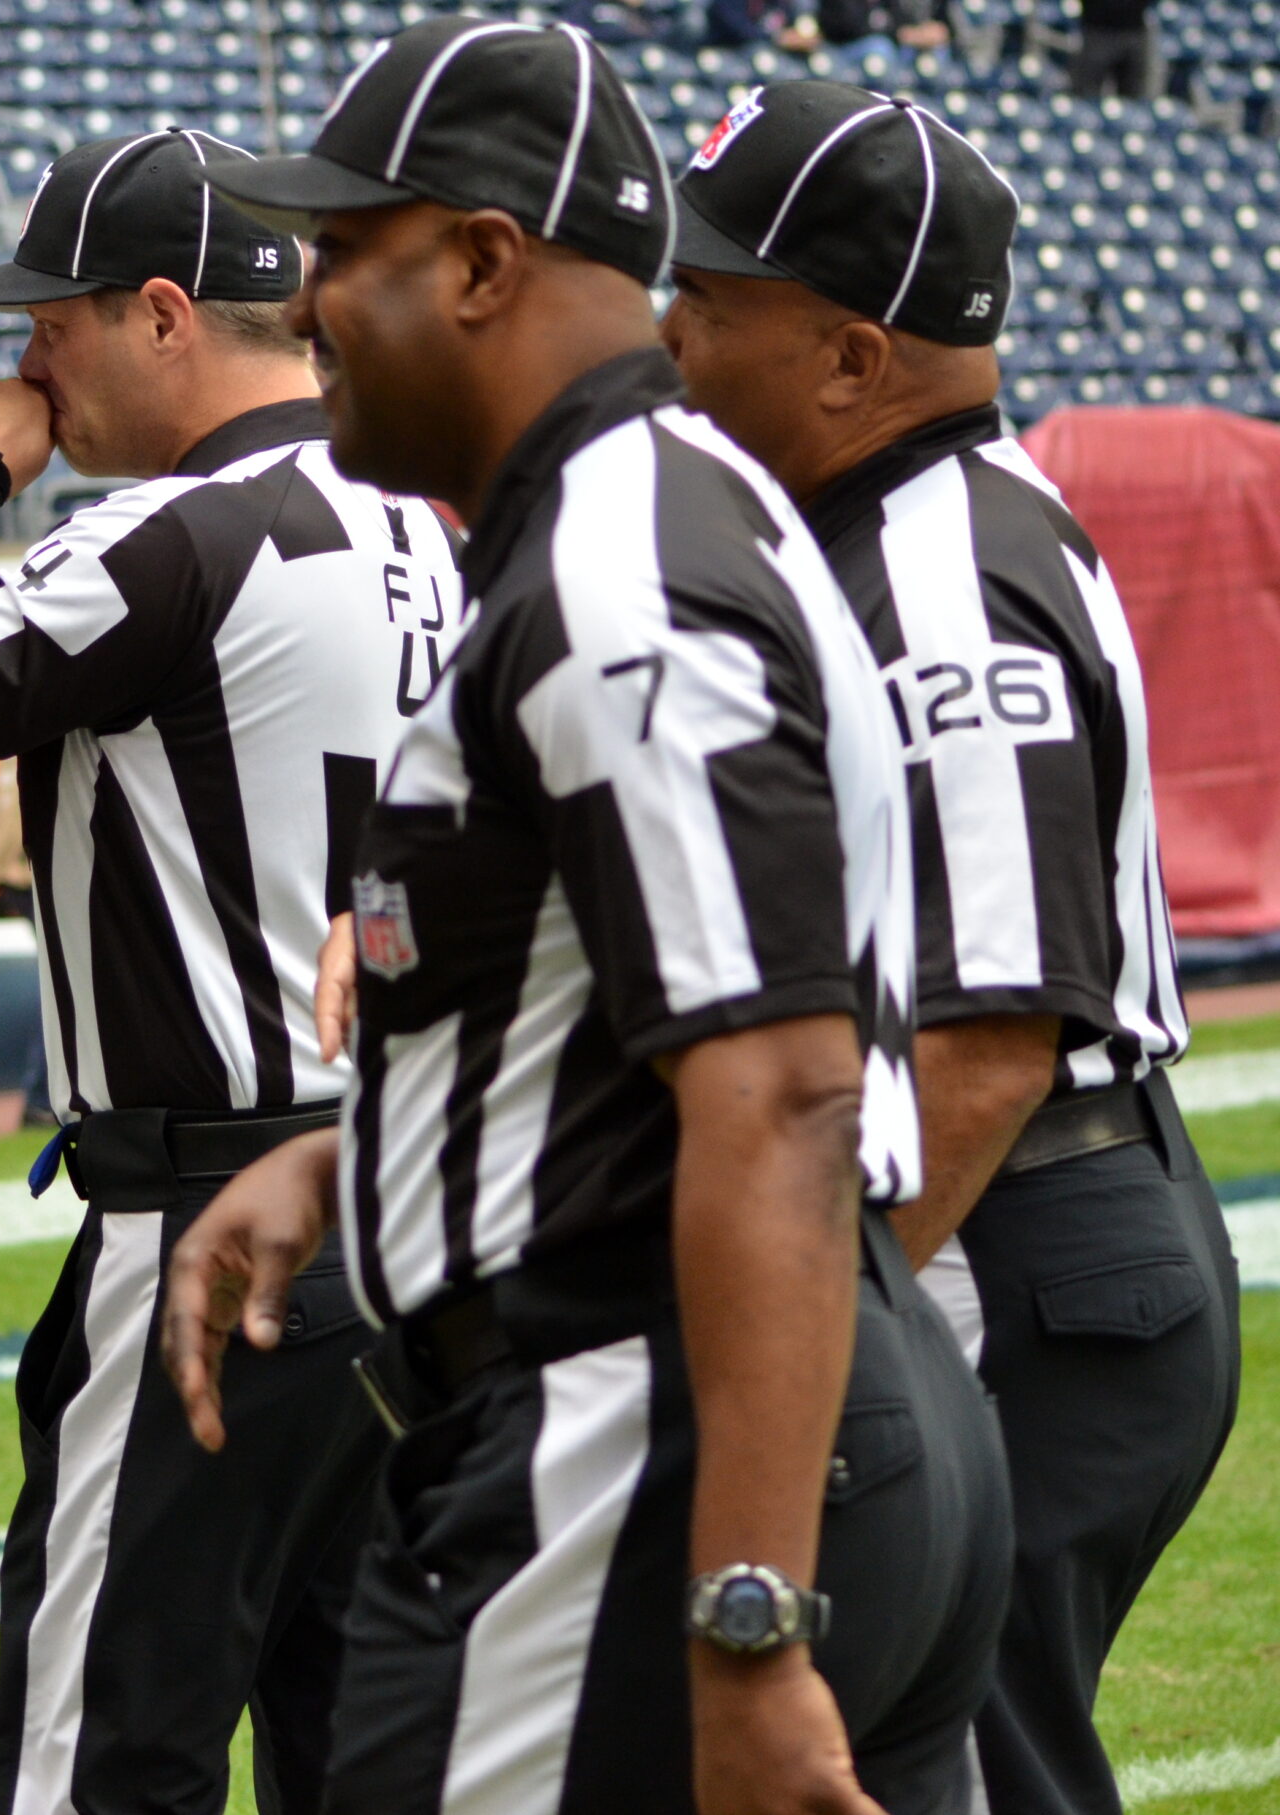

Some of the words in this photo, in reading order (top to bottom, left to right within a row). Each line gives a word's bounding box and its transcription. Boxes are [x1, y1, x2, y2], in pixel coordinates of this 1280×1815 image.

[617, 177, 648, 211] JS
[255, 247, 278, 269] JS
[963, 292, 993, 318] JS
[17, 539, 73, 592] 4
[383, 562, 445, 632] FJ
[600, 655, 667, 744] 7
[884, 658, 1052, 749] 126
[362, 914, 414, 967] NFL
